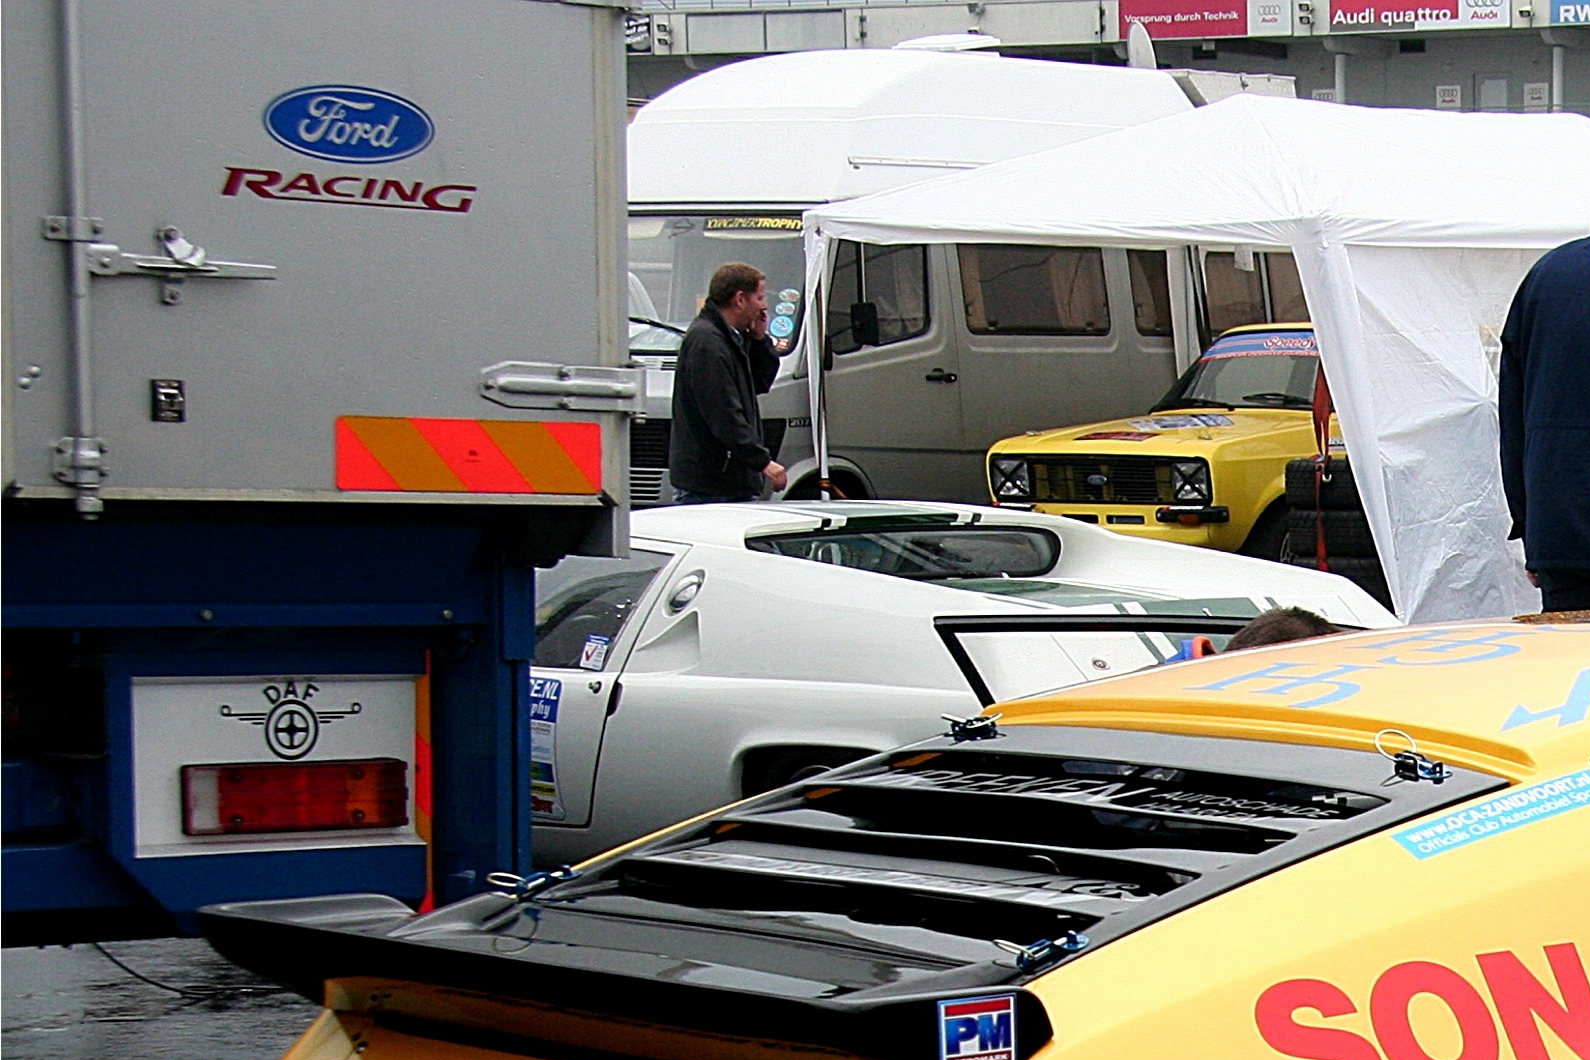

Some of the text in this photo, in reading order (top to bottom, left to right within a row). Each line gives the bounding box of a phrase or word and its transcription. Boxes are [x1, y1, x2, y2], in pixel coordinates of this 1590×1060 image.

[1124, 12, 1239, 24] Vorsprung durch Technik
[1333, 8, 1451, 26] Audi quattro
[298, 96, 401, 149] Ford
[222, 166, 478, 213] RACING
[262, 680, 321, 705] DAF
[1151, 790, 1340, 818] AUTOSCHADE
[1417, 828, 1471, 854] Officials
[1472, 817, 1500, 837] Club
[945, 1012, 1012, 1056] PM
